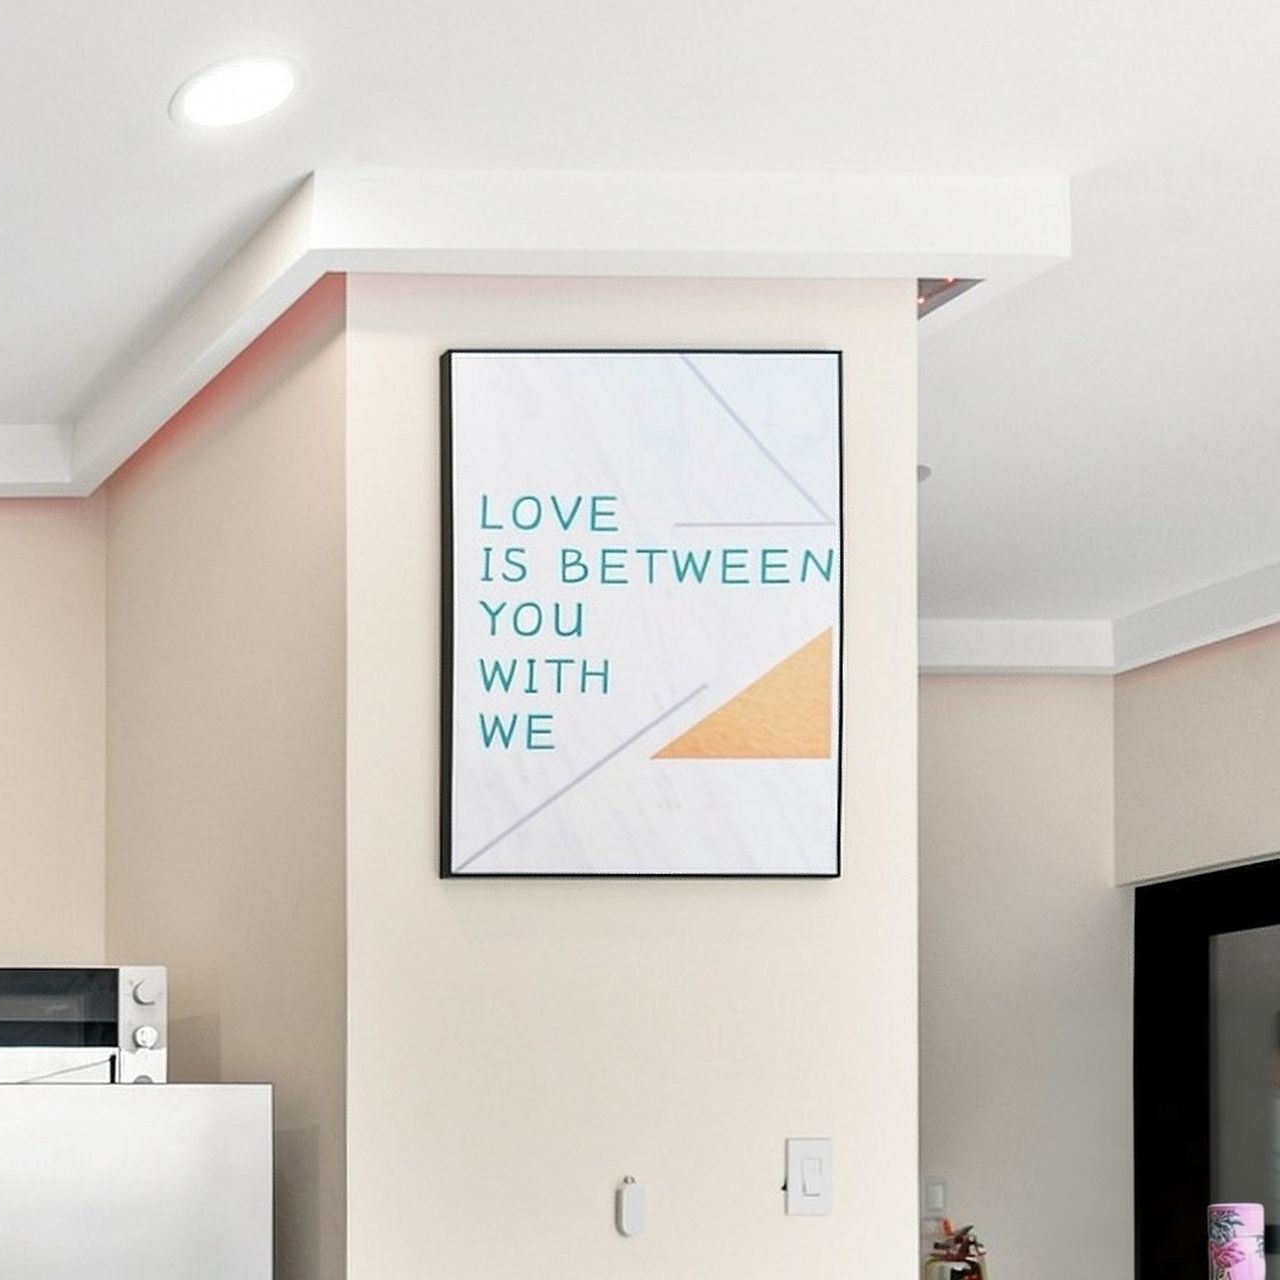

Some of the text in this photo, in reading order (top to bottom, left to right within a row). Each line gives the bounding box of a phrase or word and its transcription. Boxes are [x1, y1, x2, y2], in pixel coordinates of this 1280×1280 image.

[479, 494, 619, 532] LOVE
[480, 548, 835, 585] IS BETWEEN
[479, 600, 584, 637] YOU
[479, 658, 610, 694] WITH
[479, 713, 555, 750] WE
